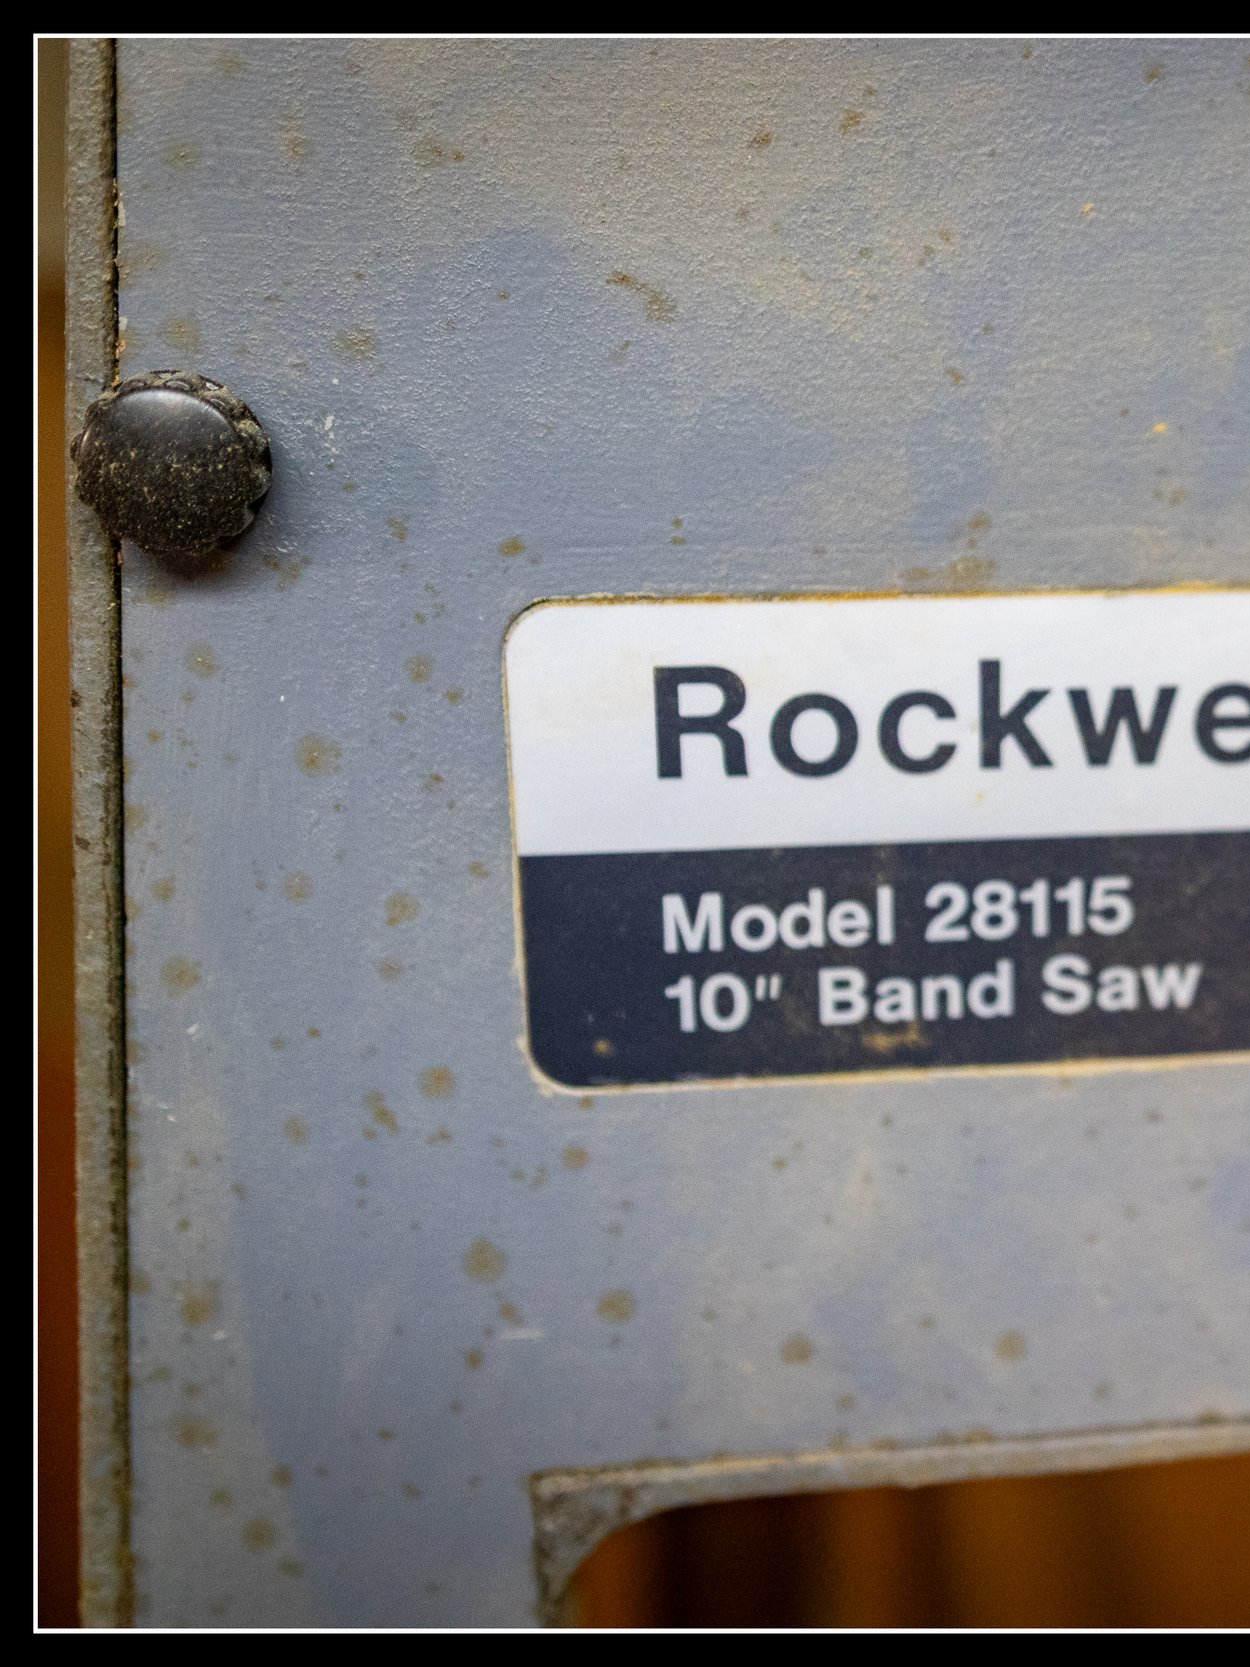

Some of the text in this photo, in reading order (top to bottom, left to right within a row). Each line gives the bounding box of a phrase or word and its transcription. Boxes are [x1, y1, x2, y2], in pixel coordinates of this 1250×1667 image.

[661, 874, 1135, 955] Model 28115
[663, 953, 1203, 1033] 10" Band Saw
